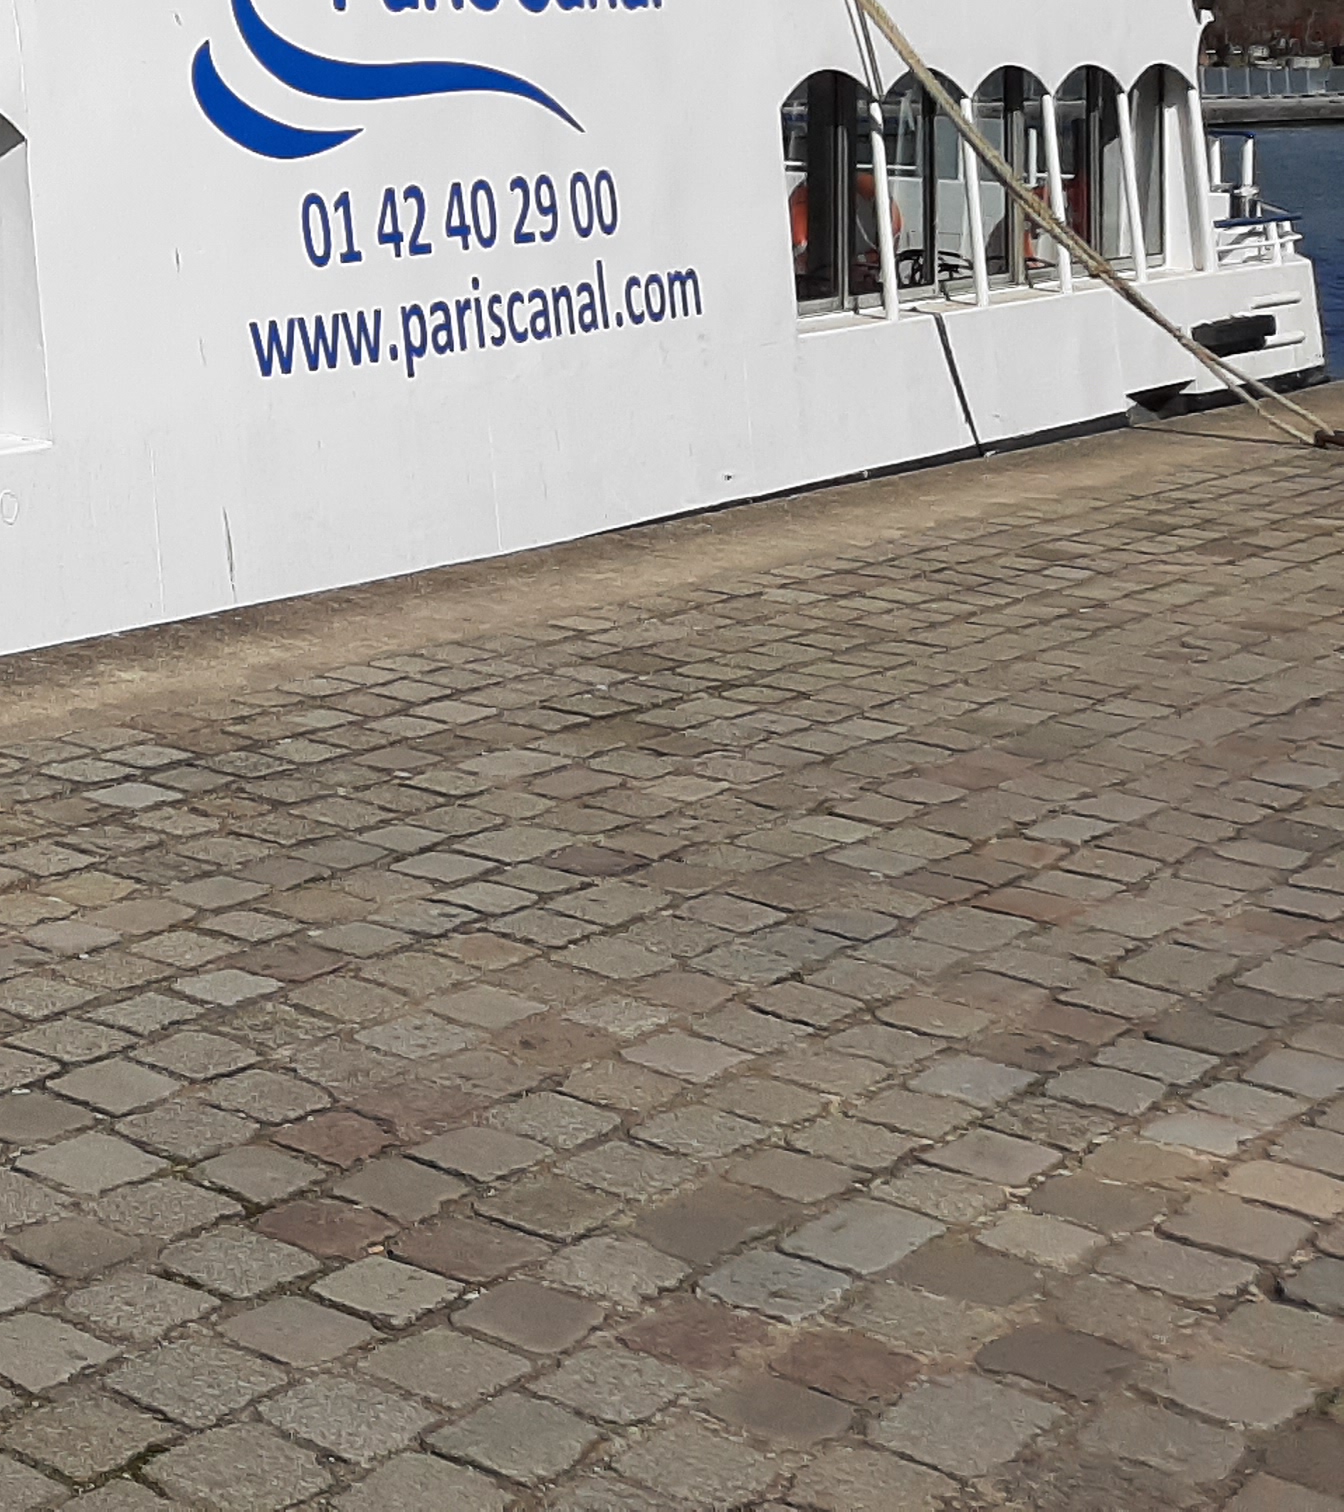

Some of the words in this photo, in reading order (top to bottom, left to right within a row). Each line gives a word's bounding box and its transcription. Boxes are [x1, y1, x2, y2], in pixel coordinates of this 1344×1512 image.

[301, 190, 363, 268] 01
[376, 184, 432, 259] 42
[444, 178, 497, 251] 40
[510, 172, 559, 245] 29
[569, 168, 619, 239] 00
[248, 259, 704, 379] www.pariscanal.com
